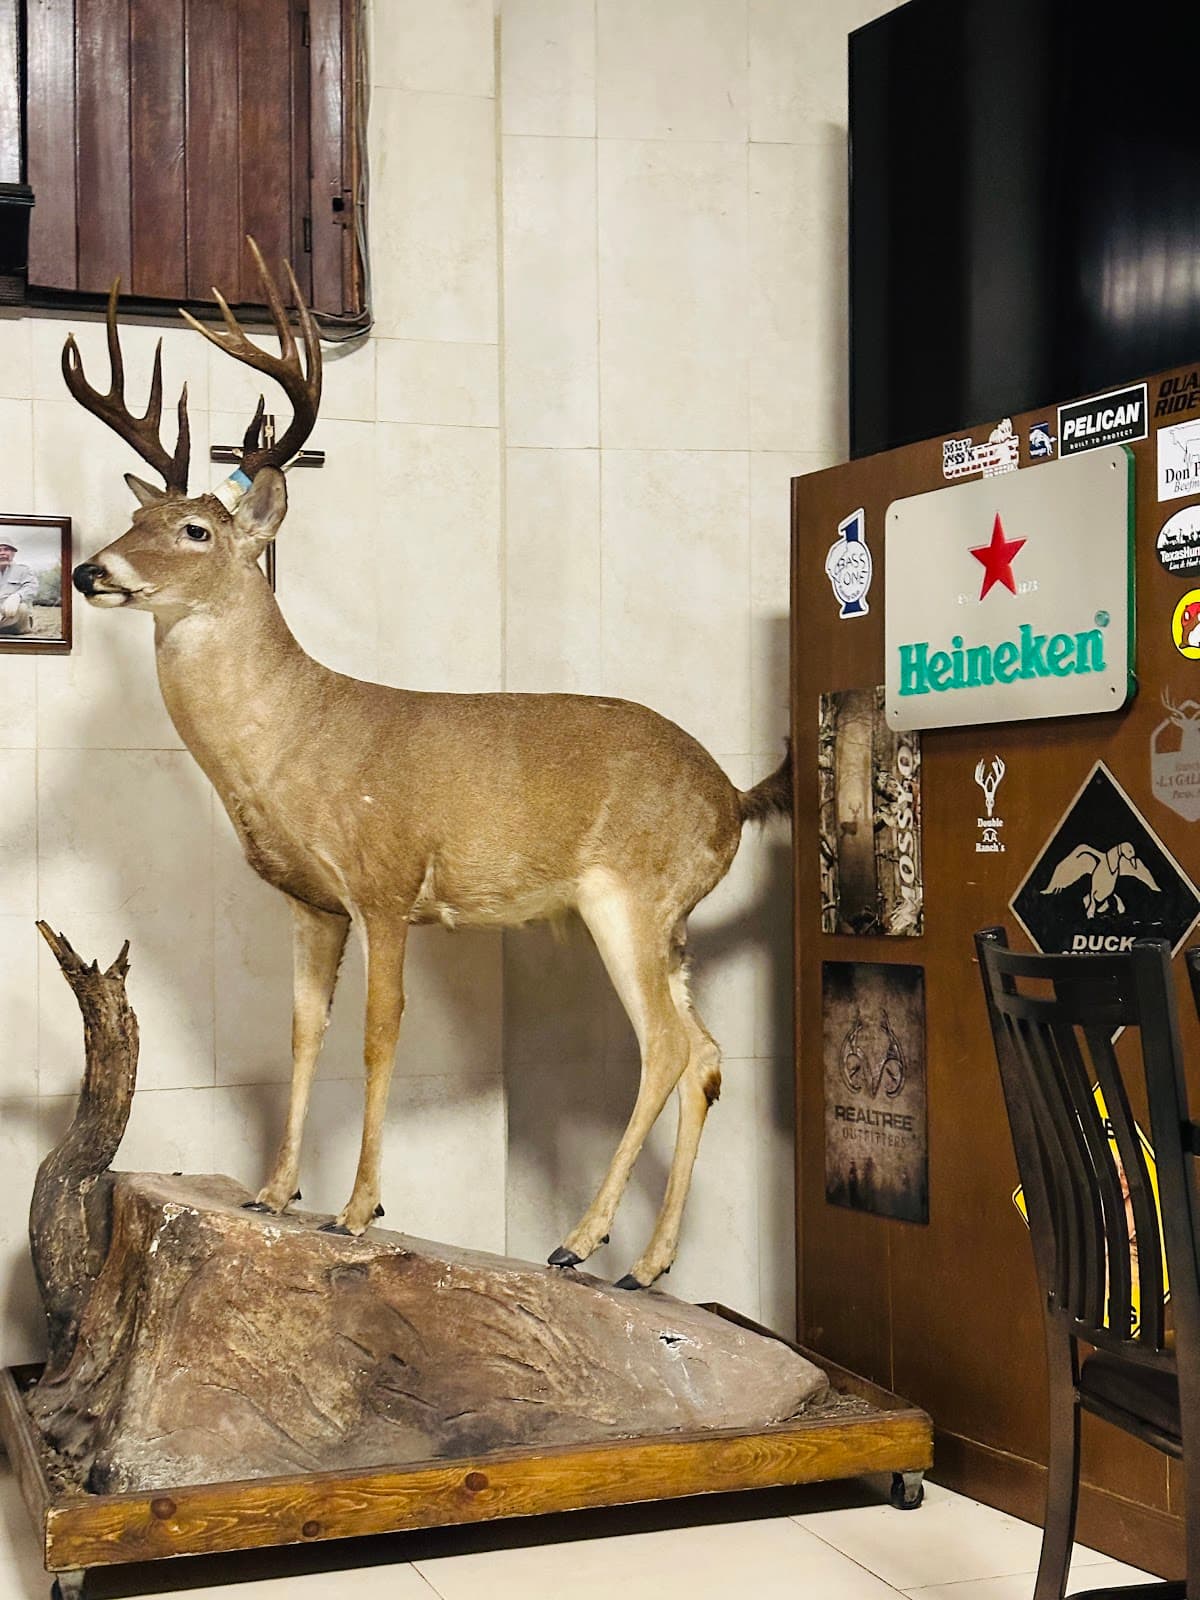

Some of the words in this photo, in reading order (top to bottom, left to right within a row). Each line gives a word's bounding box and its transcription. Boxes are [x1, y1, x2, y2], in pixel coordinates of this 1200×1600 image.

[1158, 372, 1200, 398] QUA
[1063, 402, 1140, 440] PELICAN
[1069, 438, 1089, 450] BUILT
[1091, 437, 1101, 445] TO
[1102, 428, 1133, 441] PROTECT
[1165, 468, 1190, 484] Don
[1160, 545, 1200, 563] TexasHun
[898, 624, 1107, 696] Heineken
[977, 817, 1004, 828] Double
[1072, 934, 1136, 952] DUCK
[834, 1104, 914, 1132] REALTREE
[842, 1127, 906, 1149] OUTFITTERS
